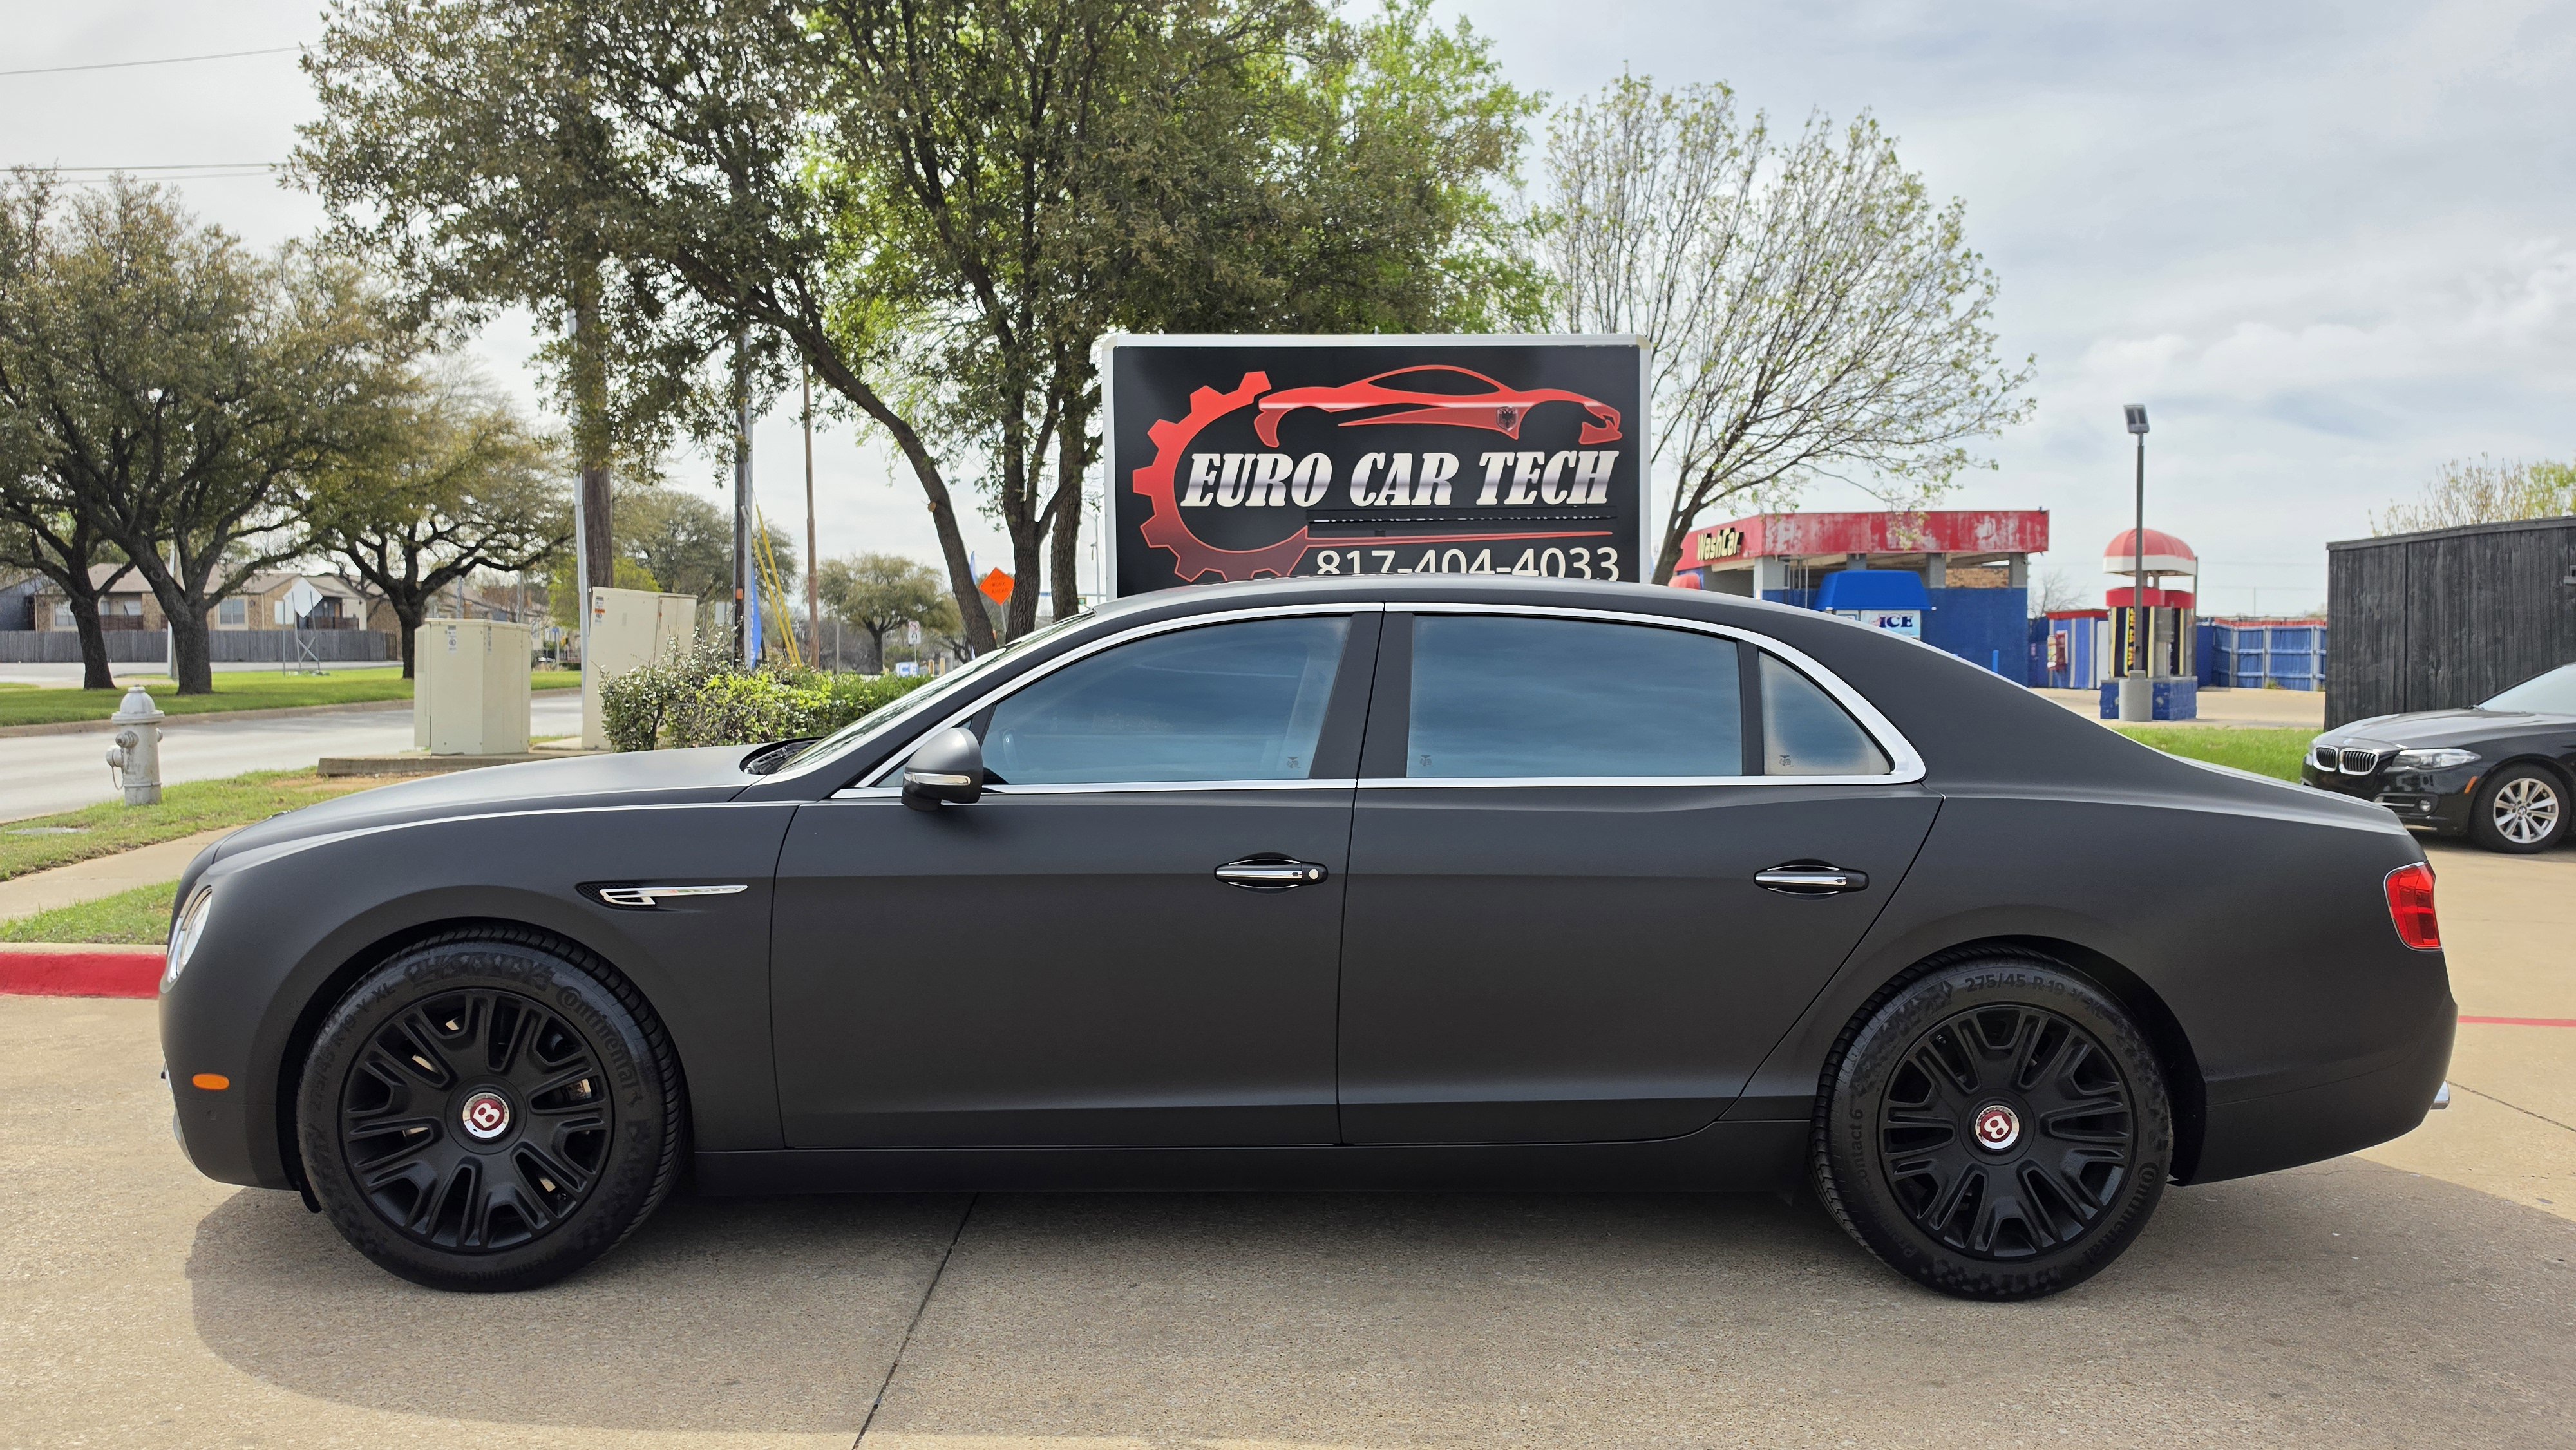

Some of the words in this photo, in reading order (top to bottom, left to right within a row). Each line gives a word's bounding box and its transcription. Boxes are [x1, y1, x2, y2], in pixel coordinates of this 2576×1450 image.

[1180, 452, 1332, 507] EURO
[1350, 451, 1459, 507] CAR
[1476, 450, 1619, 506] TECH
[1317, 547, 1619, 581] 817-404-4033
[1879, 613, 1913, 628] ICE
[1965, 973, 2027, 992] 275/45
[557, 984, 639, 1089] Continental
